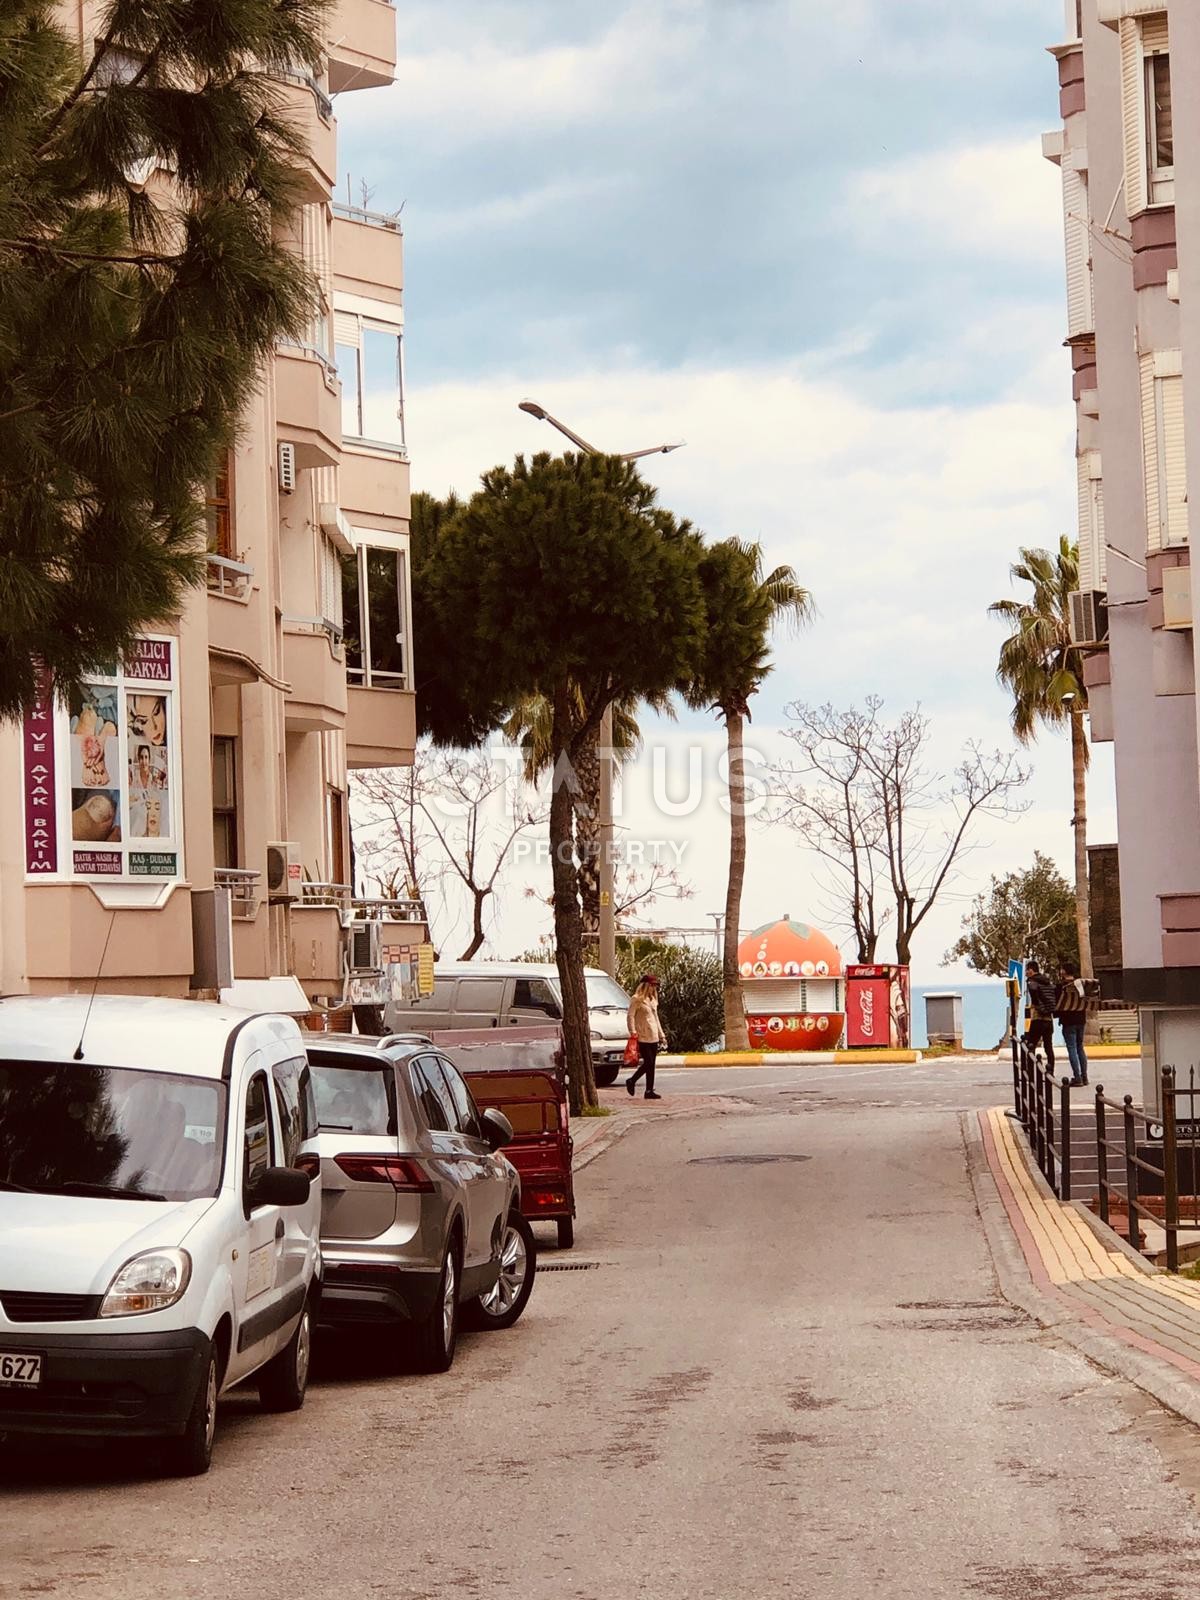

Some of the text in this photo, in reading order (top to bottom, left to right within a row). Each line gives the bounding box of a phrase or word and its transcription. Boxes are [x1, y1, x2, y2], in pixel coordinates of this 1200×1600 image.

[124, 661, 169, 679] MAKYAJ
[30, 764, 49, 806] AYAK
[30, 818, 52, 870] BAKIM
[0, 1356, 39, 1380] 627
